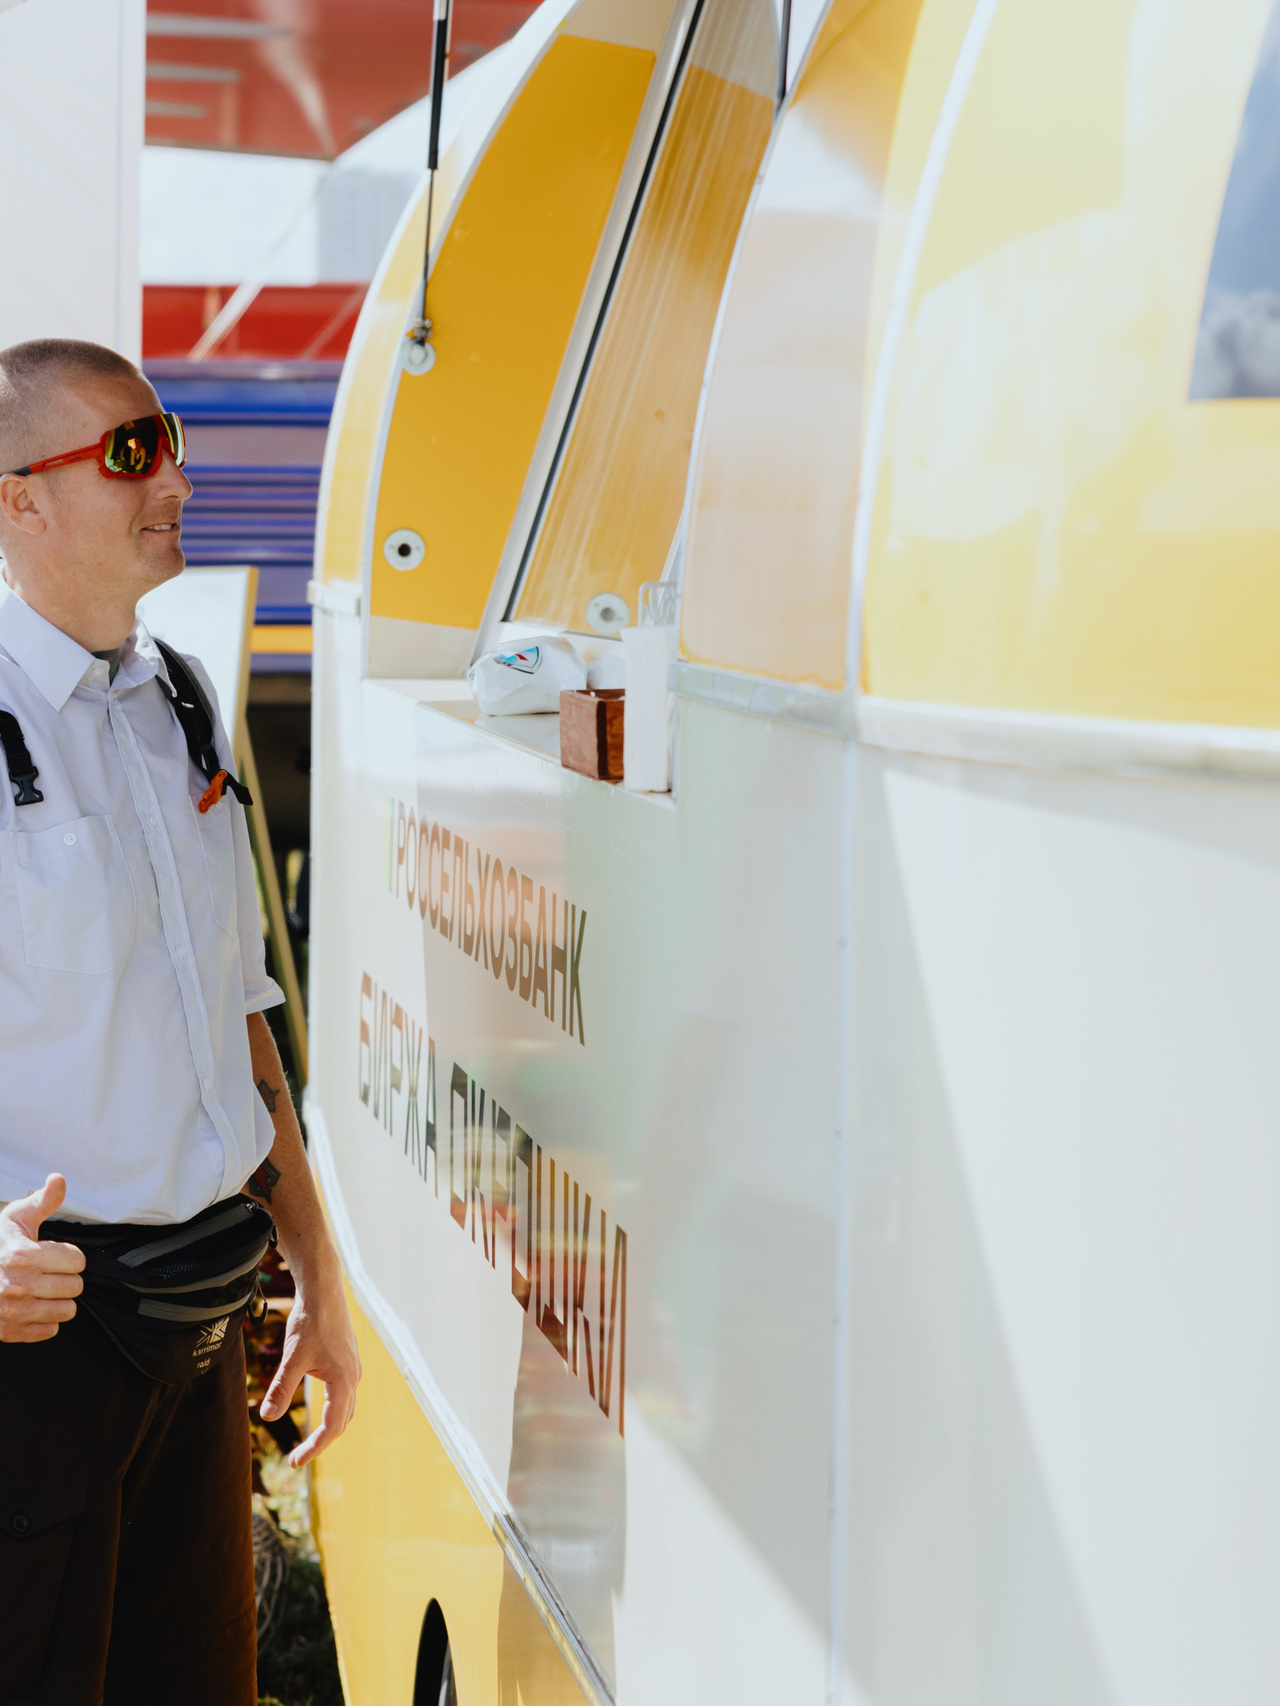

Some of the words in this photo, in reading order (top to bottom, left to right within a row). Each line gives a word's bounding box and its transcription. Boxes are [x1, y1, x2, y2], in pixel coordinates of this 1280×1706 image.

[396, 800, 587, 1047] РОССЕЛЬХОЗБАНК
[359, 971, 438, 1199] БИРЖА
[450, 1062, 627, 1439] ОКРОШКИ
